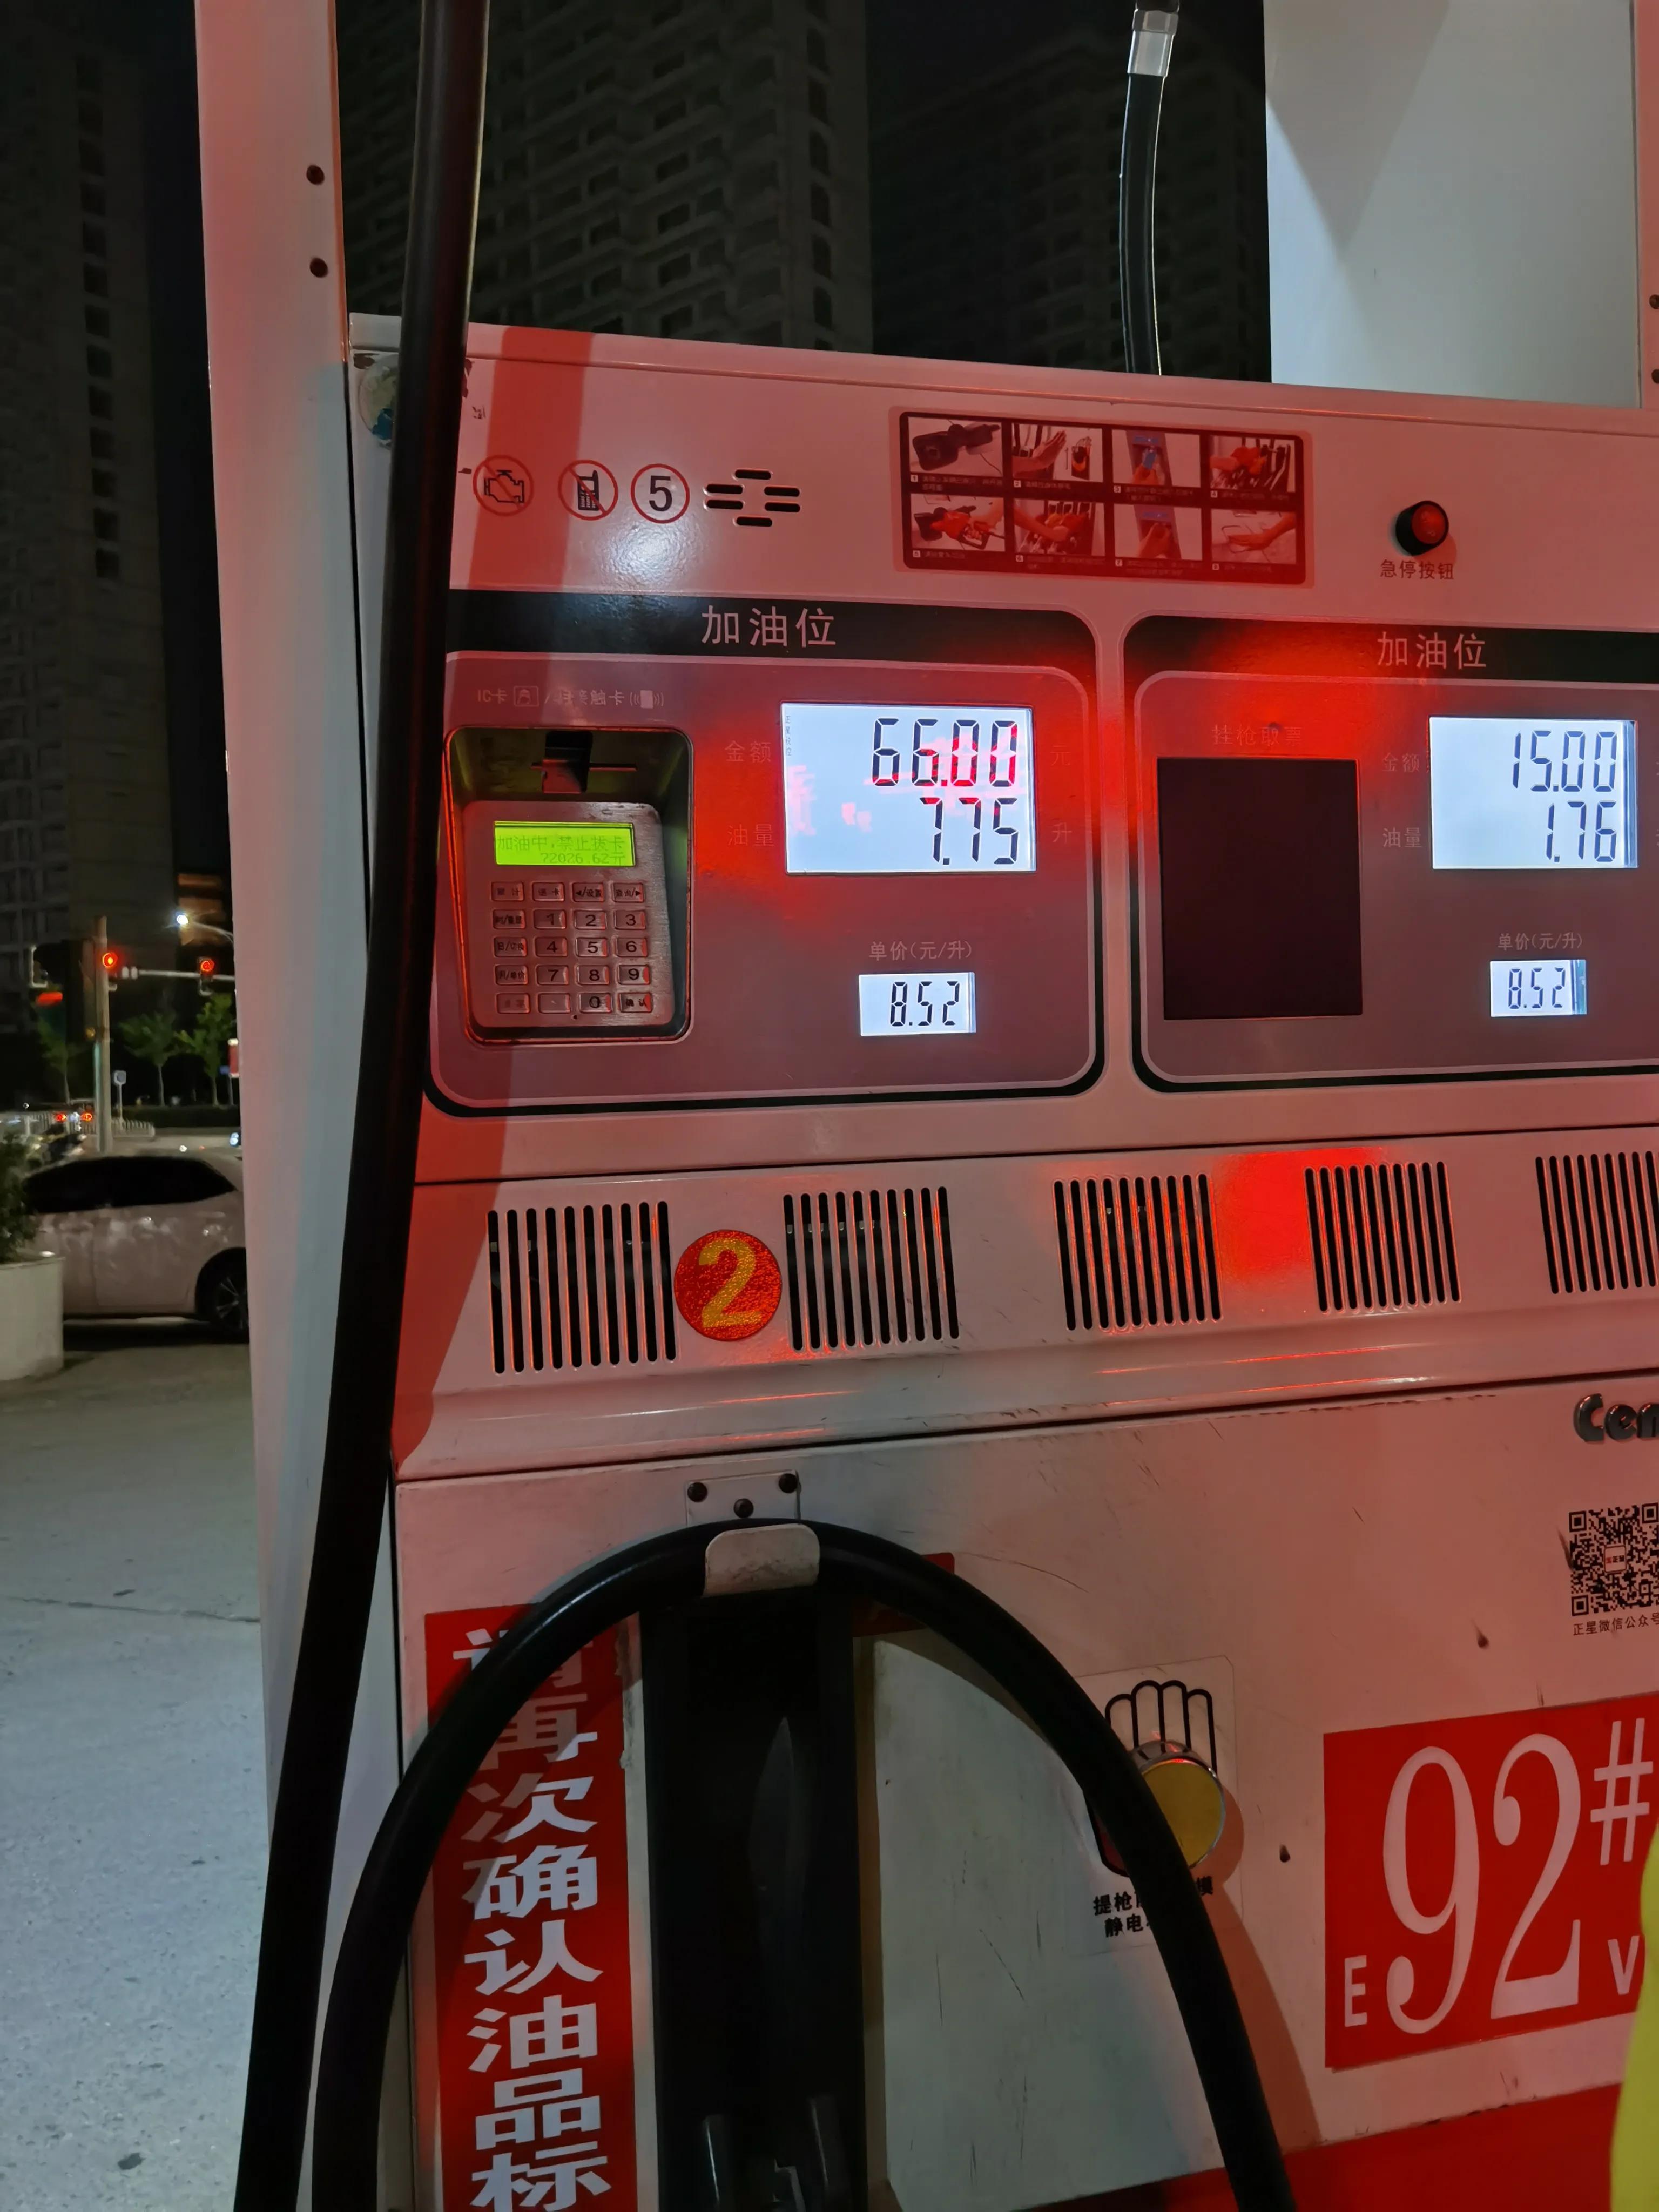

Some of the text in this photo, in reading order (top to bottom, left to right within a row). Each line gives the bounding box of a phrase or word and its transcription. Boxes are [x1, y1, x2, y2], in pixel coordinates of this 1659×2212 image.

[649, 475, 673, 512] 5
[1380, 559, 1454, 580] 急停按钮
[702, 605, 837, 648] 加油位
[1377, 631, 1487, 670] 加油位
[1211, 724, 1303, 746] 挂枪取票
[724, 740, 772, 763] 金额
[872, 718, 1017, 787] 66.00
[1050, 745, 1071, 766] 元
[1512, 730, 1617, 792] 15.00
[1382, 752, 1420, 773] 金额
[727, 824, 775, 847] 油量
[919, 797, 1019, 865] 7.75
[1049, 821, 1072, 844] 升
[1382, 827, 1422, 848] 油量
[1546, 801, 1617, 862] 1.76
[546, 913, 554, 925] 1
[585, 914, 596, 926] 2
[625, 914, 636, 926] 3
[546, 941, 557, 953] 4
[587, 941, 598, 953] 5
[626, 941, 637, 953] 6
[869, 940, 972, 961] 单价(元/升)
[1497, 932, 1583, 951] 单价(元/升)
[548, 969, 558, 981] 7
[589, 969, 600, 981] 8
[628, 968, 639, 980] 9
[1508, 967, 1565, 1009] 8.52
[589, 996, 600, 1009] 0
[890, 981, 960, 1026] 8.52
[698, 1238, 762, 1328] 2
[1573, 1612, 1659, 1636] 正星微信公众号
[1344, 1955, 1367, 2027] E
